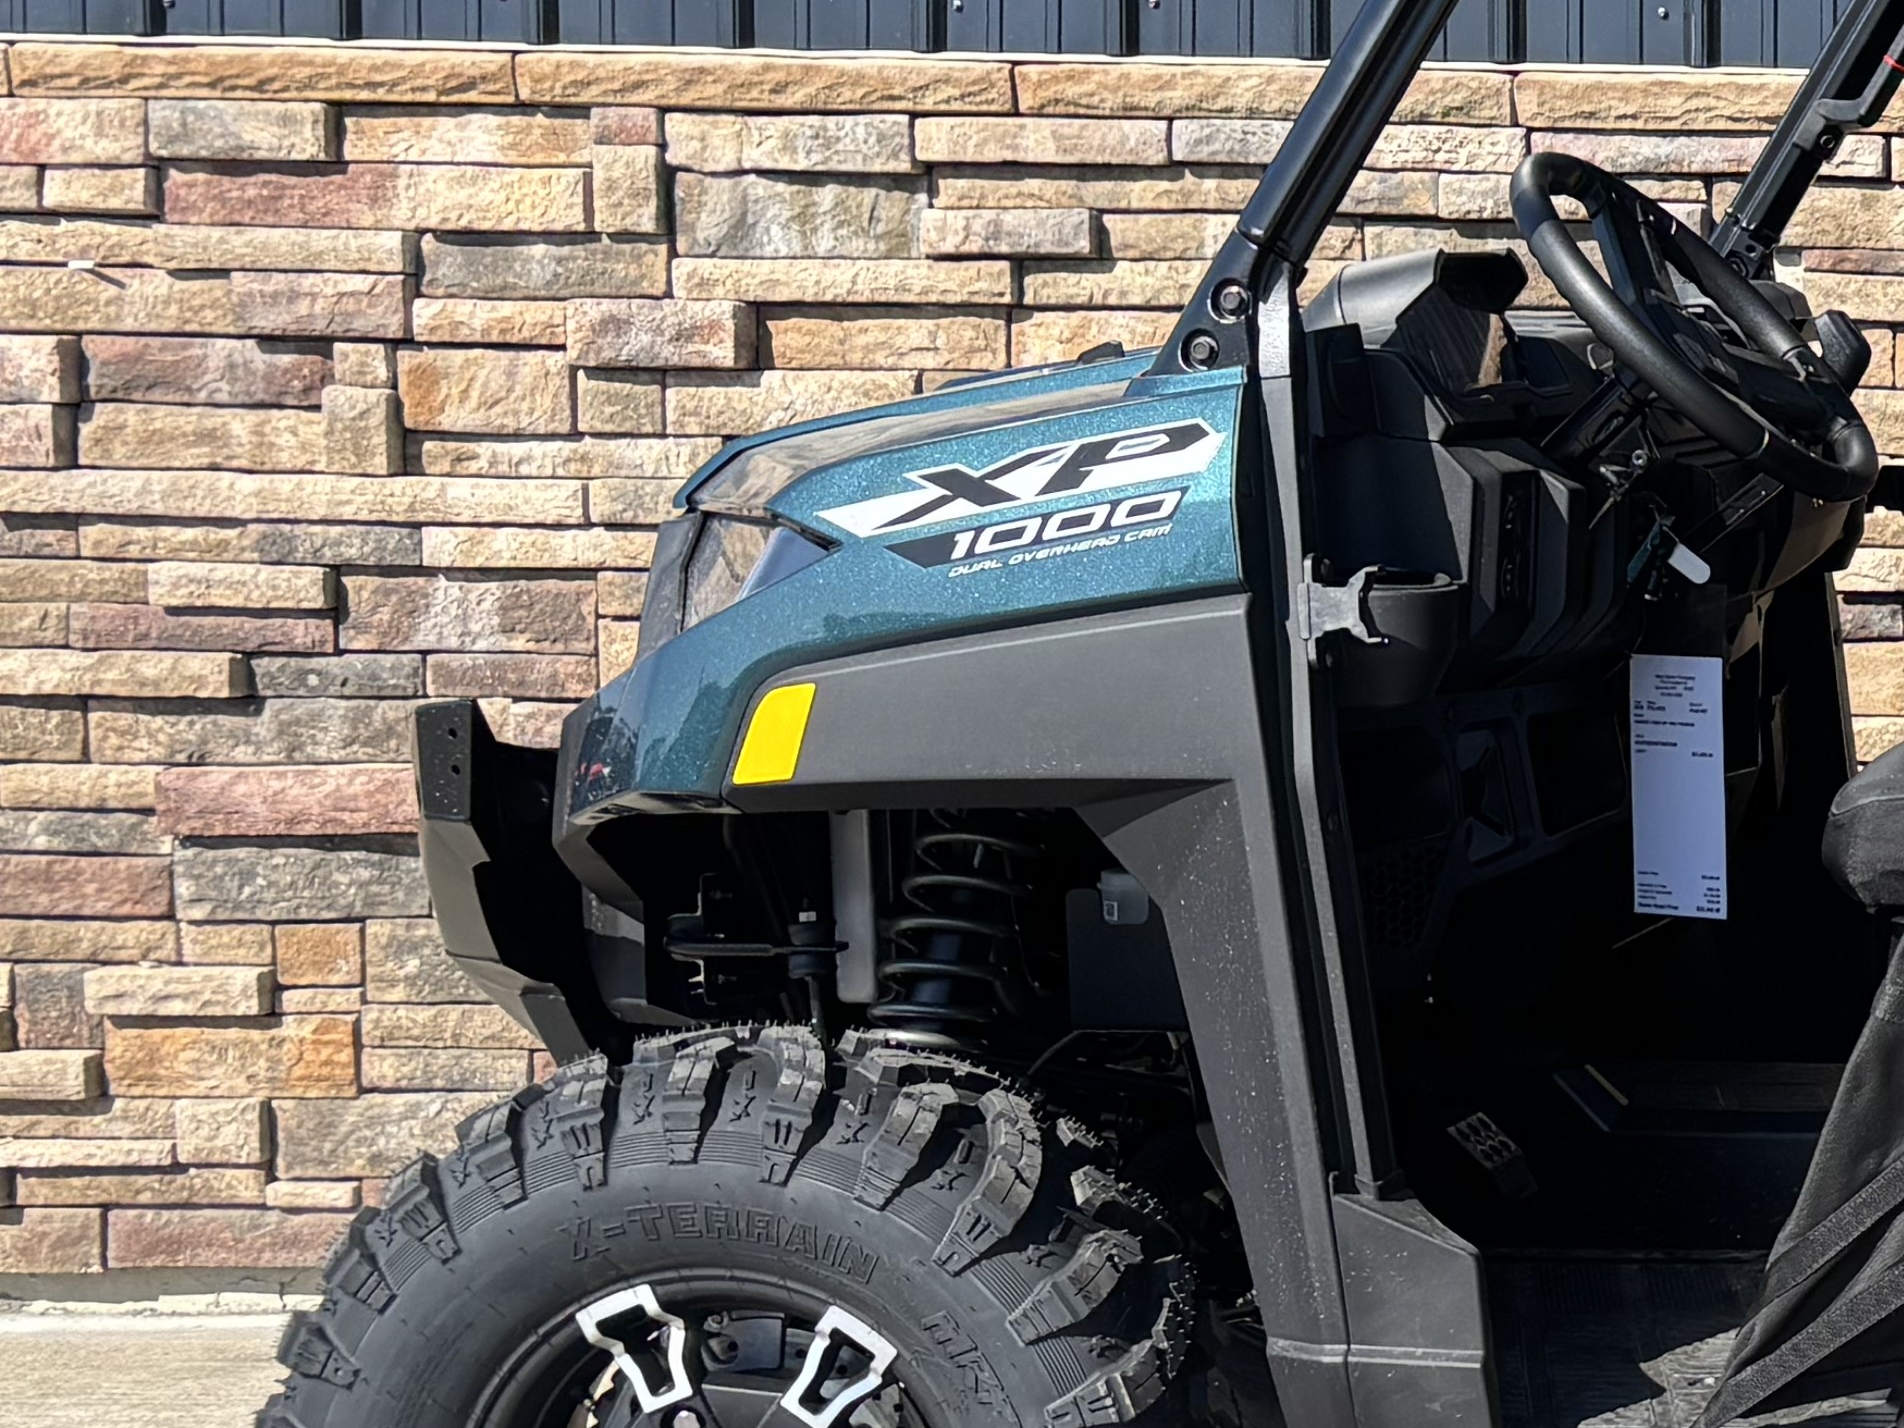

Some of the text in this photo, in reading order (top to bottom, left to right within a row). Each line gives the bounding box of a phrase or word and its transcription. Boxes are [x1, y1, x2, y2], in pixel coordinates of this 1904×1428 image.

[870, 421, 1212, 532] XP
[948, 522, 1174, 578] DUAL OVERHEAD CAM
[950, 490, 1184, 561] 1000
